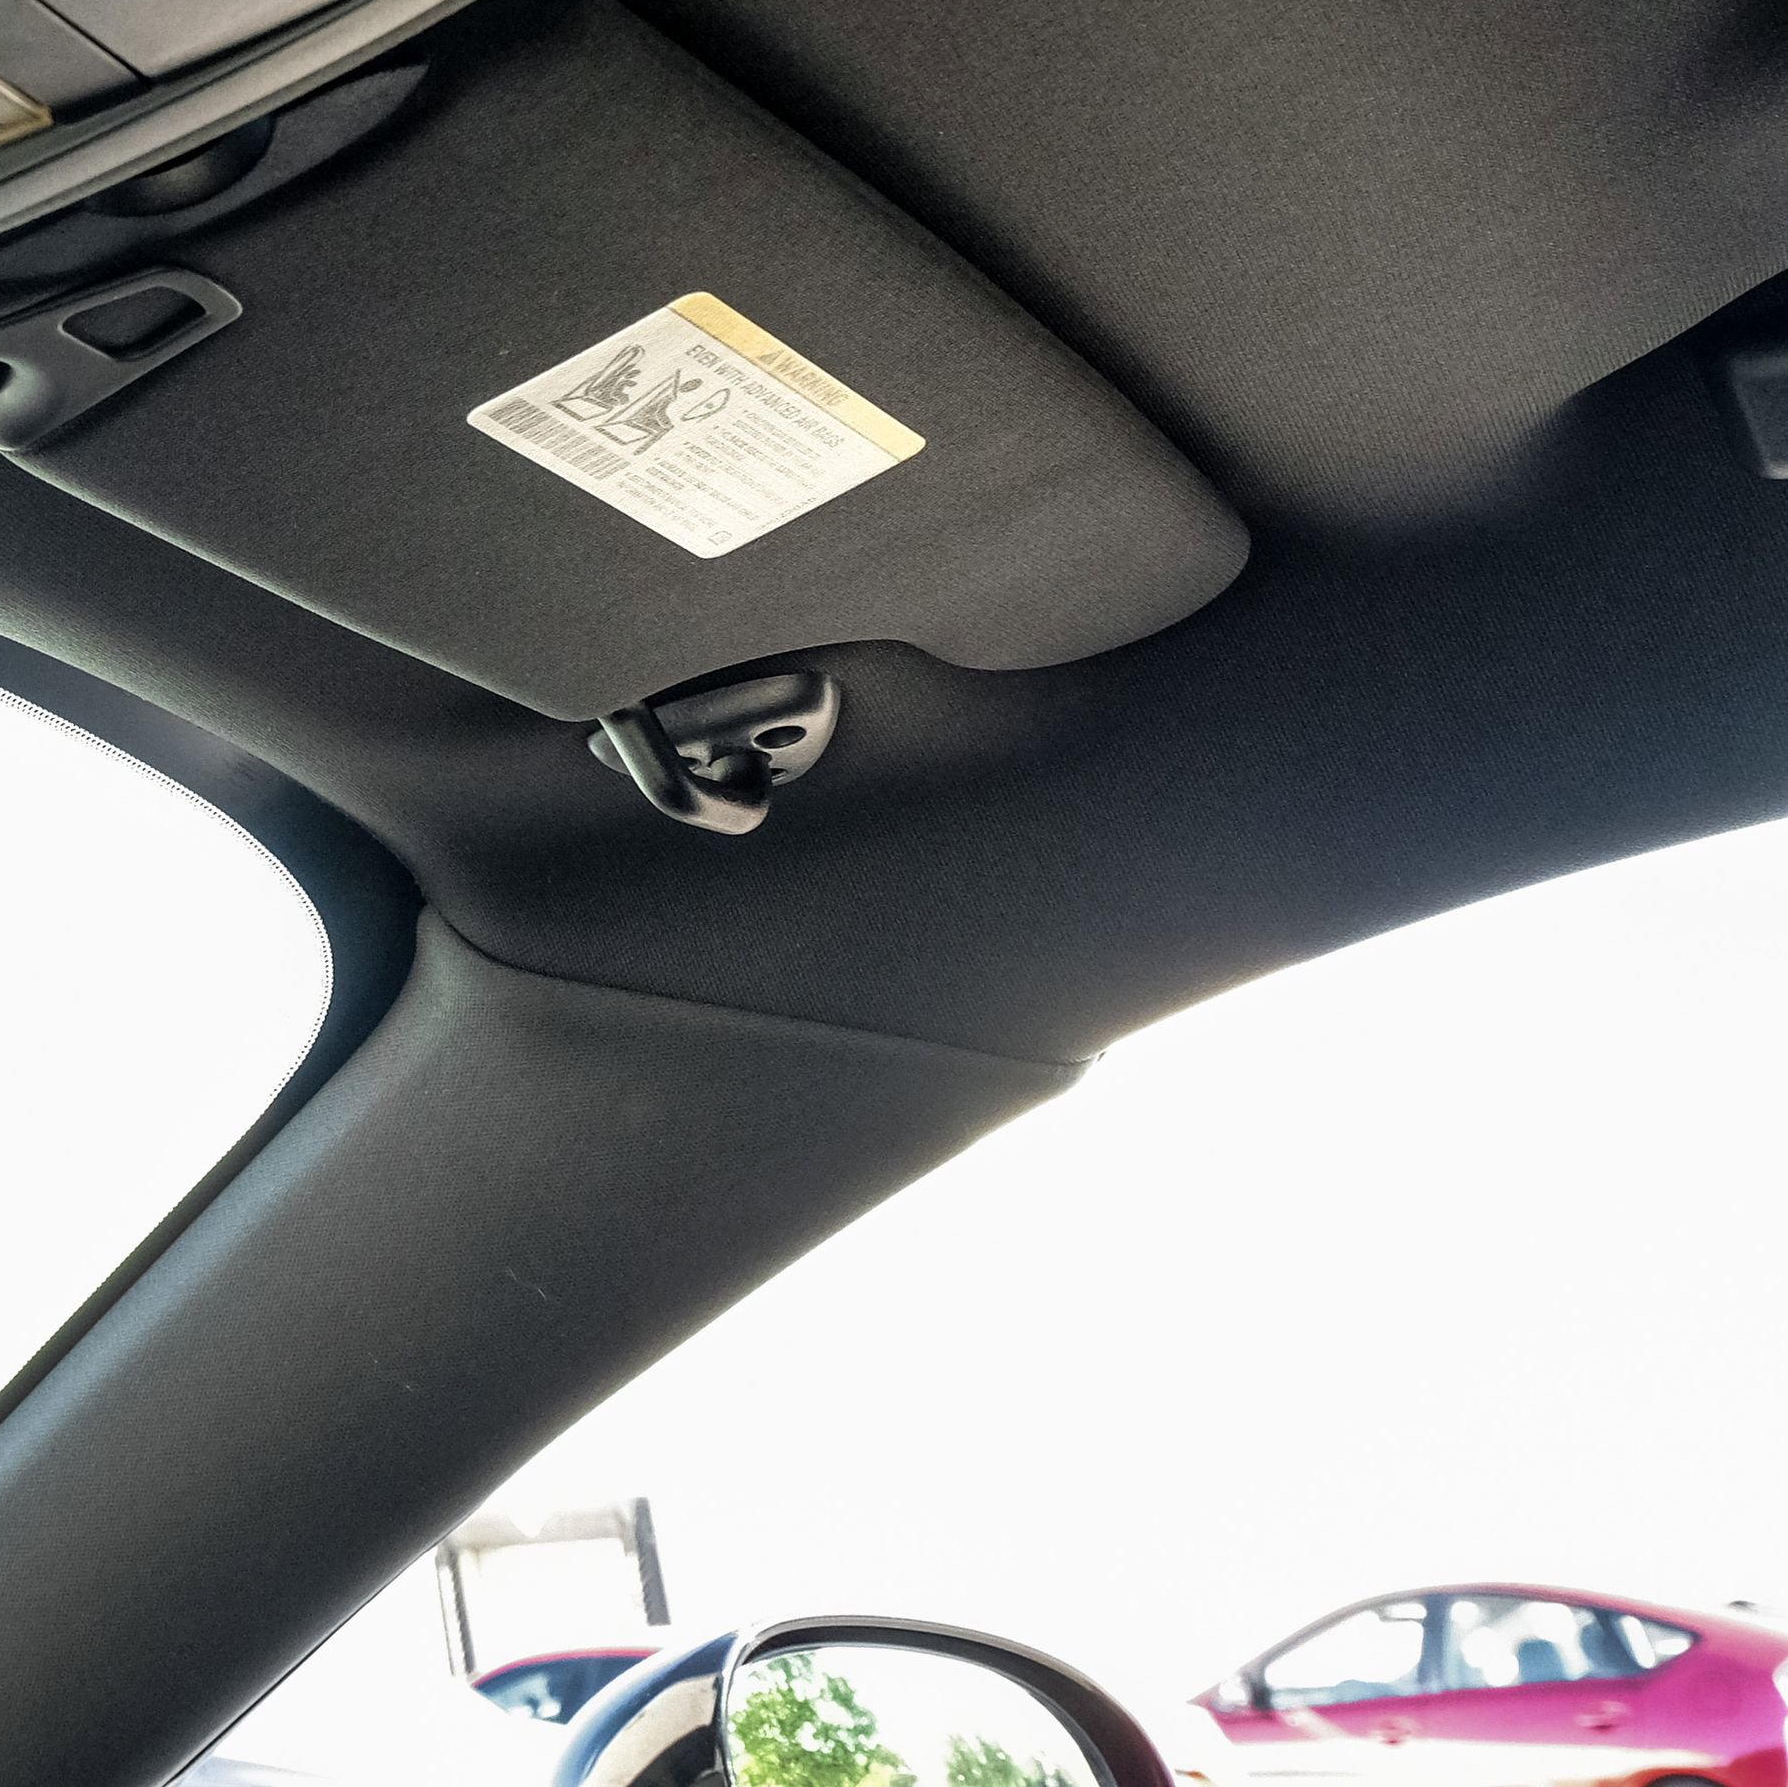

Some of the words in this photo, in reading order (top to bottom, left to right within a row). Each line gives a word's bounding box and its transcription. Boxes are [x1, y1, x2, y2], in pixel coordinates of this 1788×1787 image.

[685, 344, 721, 370] EVEN
[715, 364, 748, 387] WITH
[742, 378, 801, 420] ADVANCED
[794, 415, 819, 431] AIR
[811, 427, 846, 448] BAGS
[775, 357, 849, 407] WARNING
